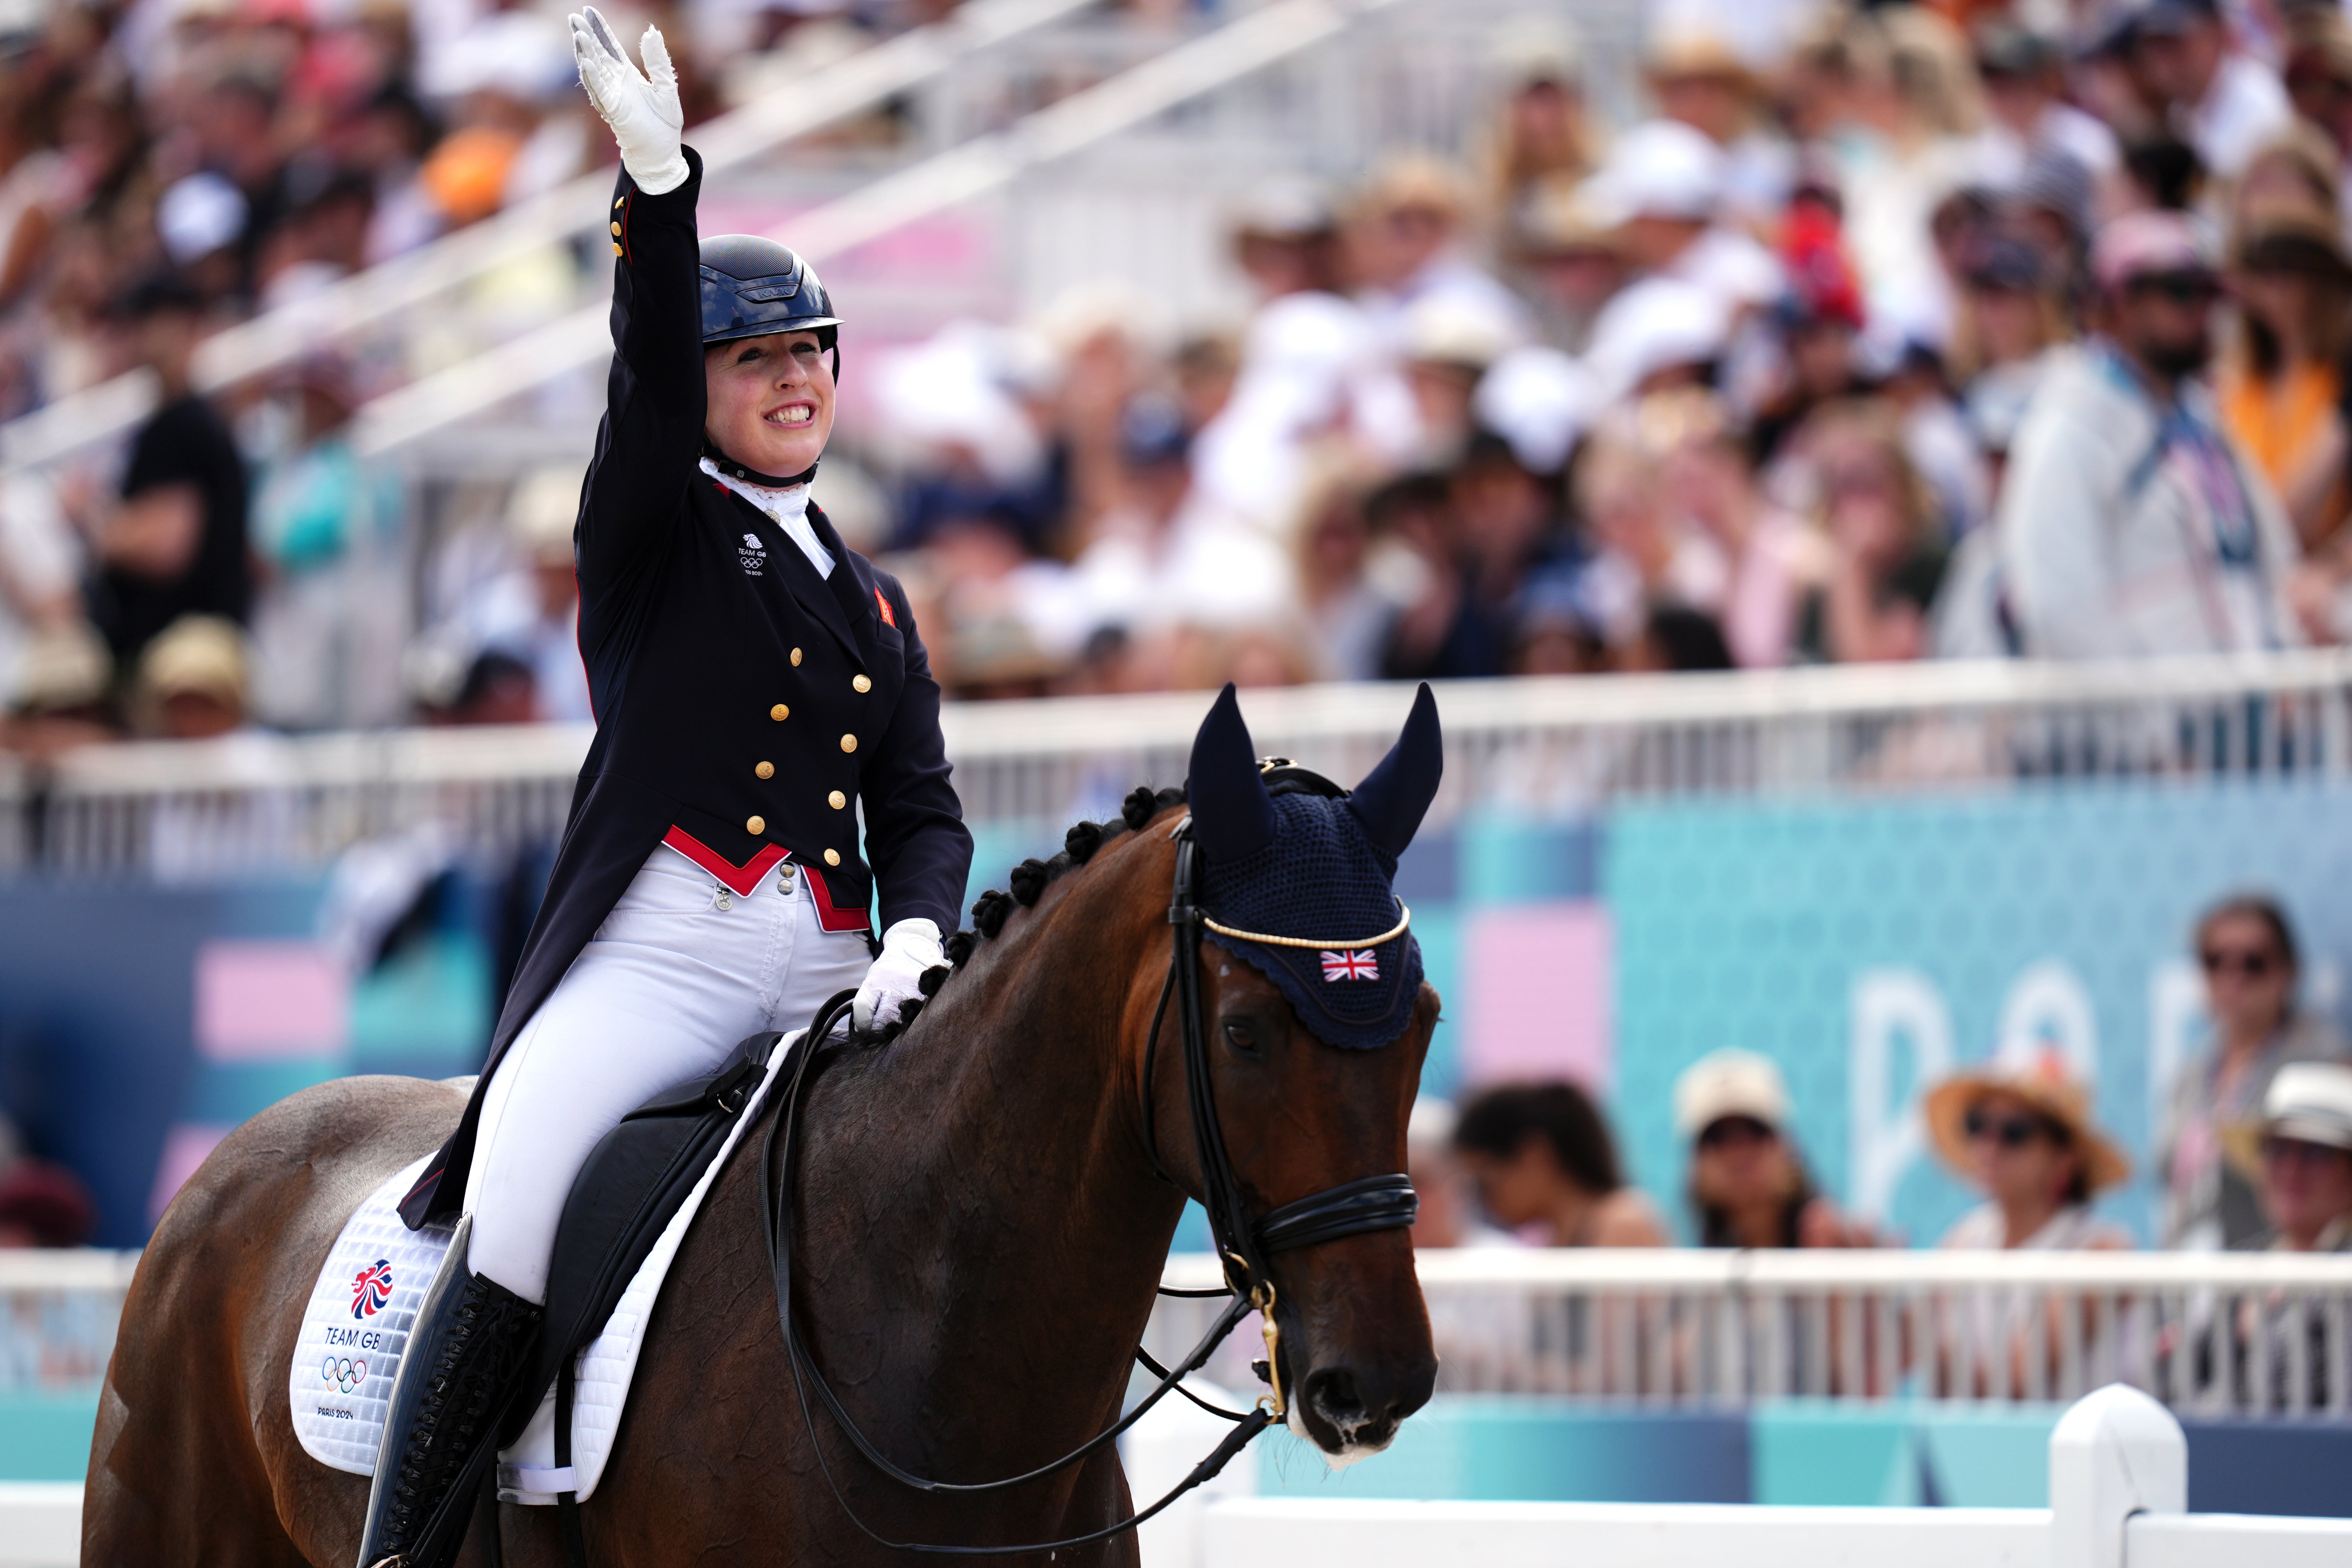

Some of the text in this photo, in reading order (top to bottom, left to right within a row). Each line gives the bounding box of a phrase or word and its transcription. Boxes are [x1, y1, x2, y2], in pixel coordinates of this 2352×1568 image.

[325, 1328, 381, 1349] TEAM GB
[336, 1409, 353, 1420] 2024
